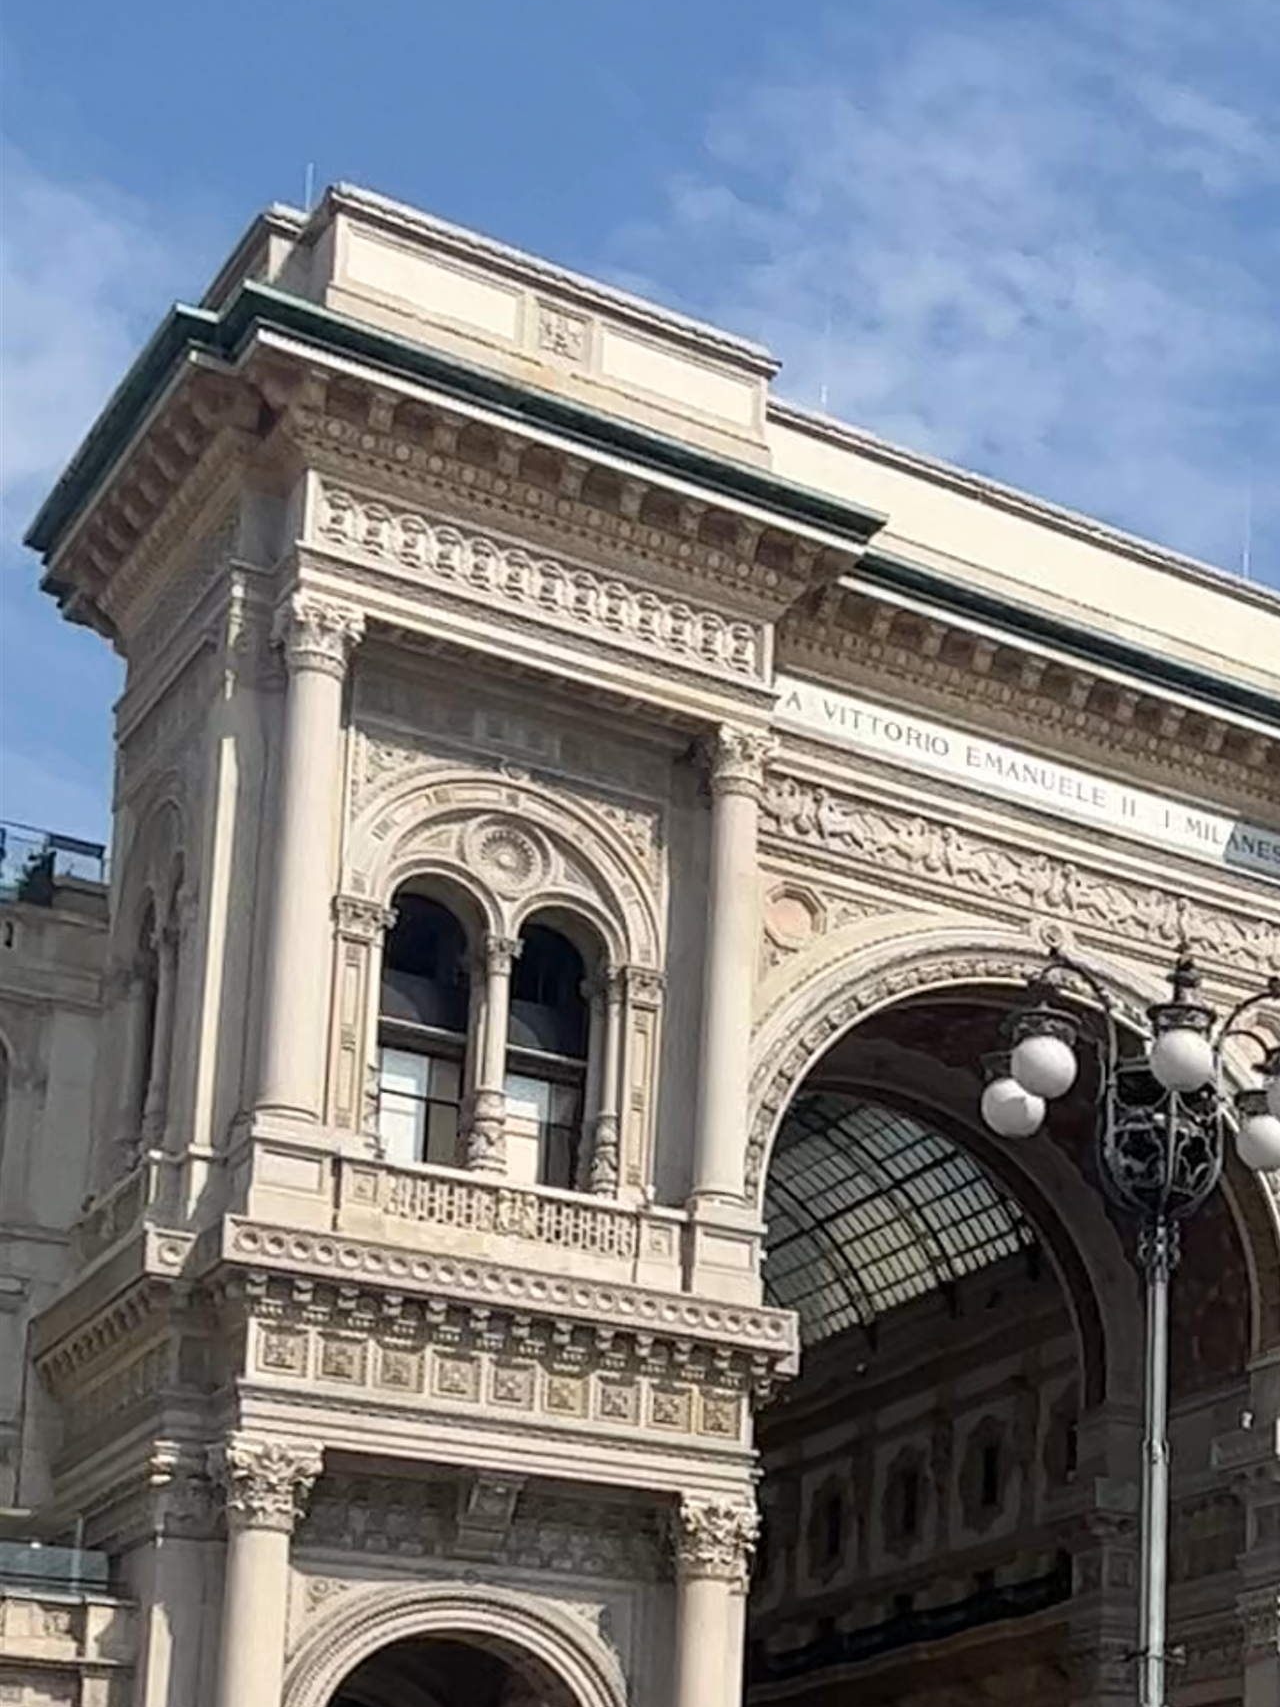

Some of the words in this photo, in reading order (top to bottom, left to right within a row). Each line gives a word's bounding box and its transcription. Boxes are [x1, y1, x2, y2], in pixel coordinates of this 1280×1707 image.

[785, 691, 802, 711] A
[823, 699, 949, 757] VITTORIO
[966, 746, 1107, 808] EMANUELE
[1121, 795, 1136, 818] II
